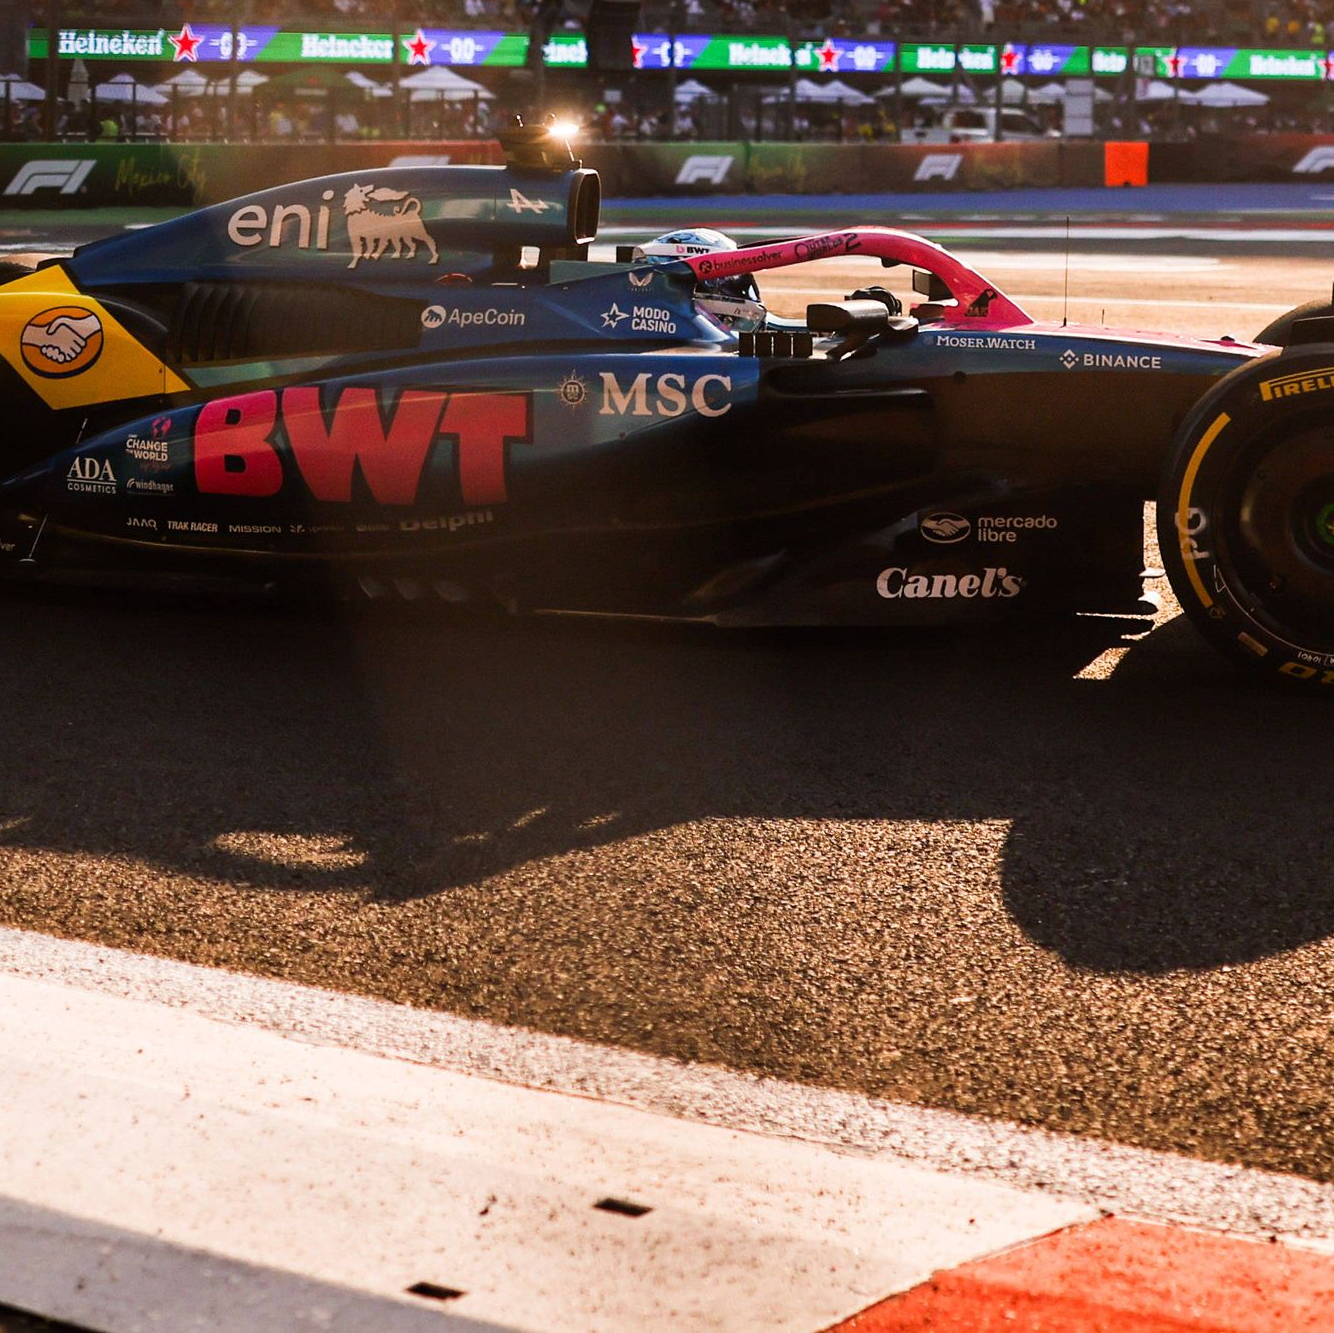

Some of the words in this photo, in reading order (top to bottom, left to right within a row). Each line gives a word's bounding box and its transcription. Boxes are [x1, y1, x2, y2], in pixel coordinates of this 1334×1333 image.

[227, 189, 335, 250] eni
[843, 232, 862, 252] 2
[714, 249, 783, 270] businessolver
[448, 308, 526, 327] ApeCoin
[632, 305, 671, 322] MODO
[631, 319, 677, 335] CASINO
[937, 335, 1036, 350] MOSER.WATCH
[1083, 353, 1162, 369] BINANCE
[599, 372, 732, 417] MSC
[125, 438, 169, 453] CHANGE
[194, 386, 529, 507] BWT
[133, 449, 169, 463] WORLD
[67, 456, 116, 483] ADA
[67, 481, 117, 495] COSMETICS
[167, 520, 190, 532] TRAK
[190, 522, 219, 533] RACER
[228, 524, 283, 534] MISSION
[398, 510, 495, 532] Delphi
[977, 515, 1058, 530] mercado
[977, 527, 1017, 542] libre
[876, 567, 1022, 599] Canel's
